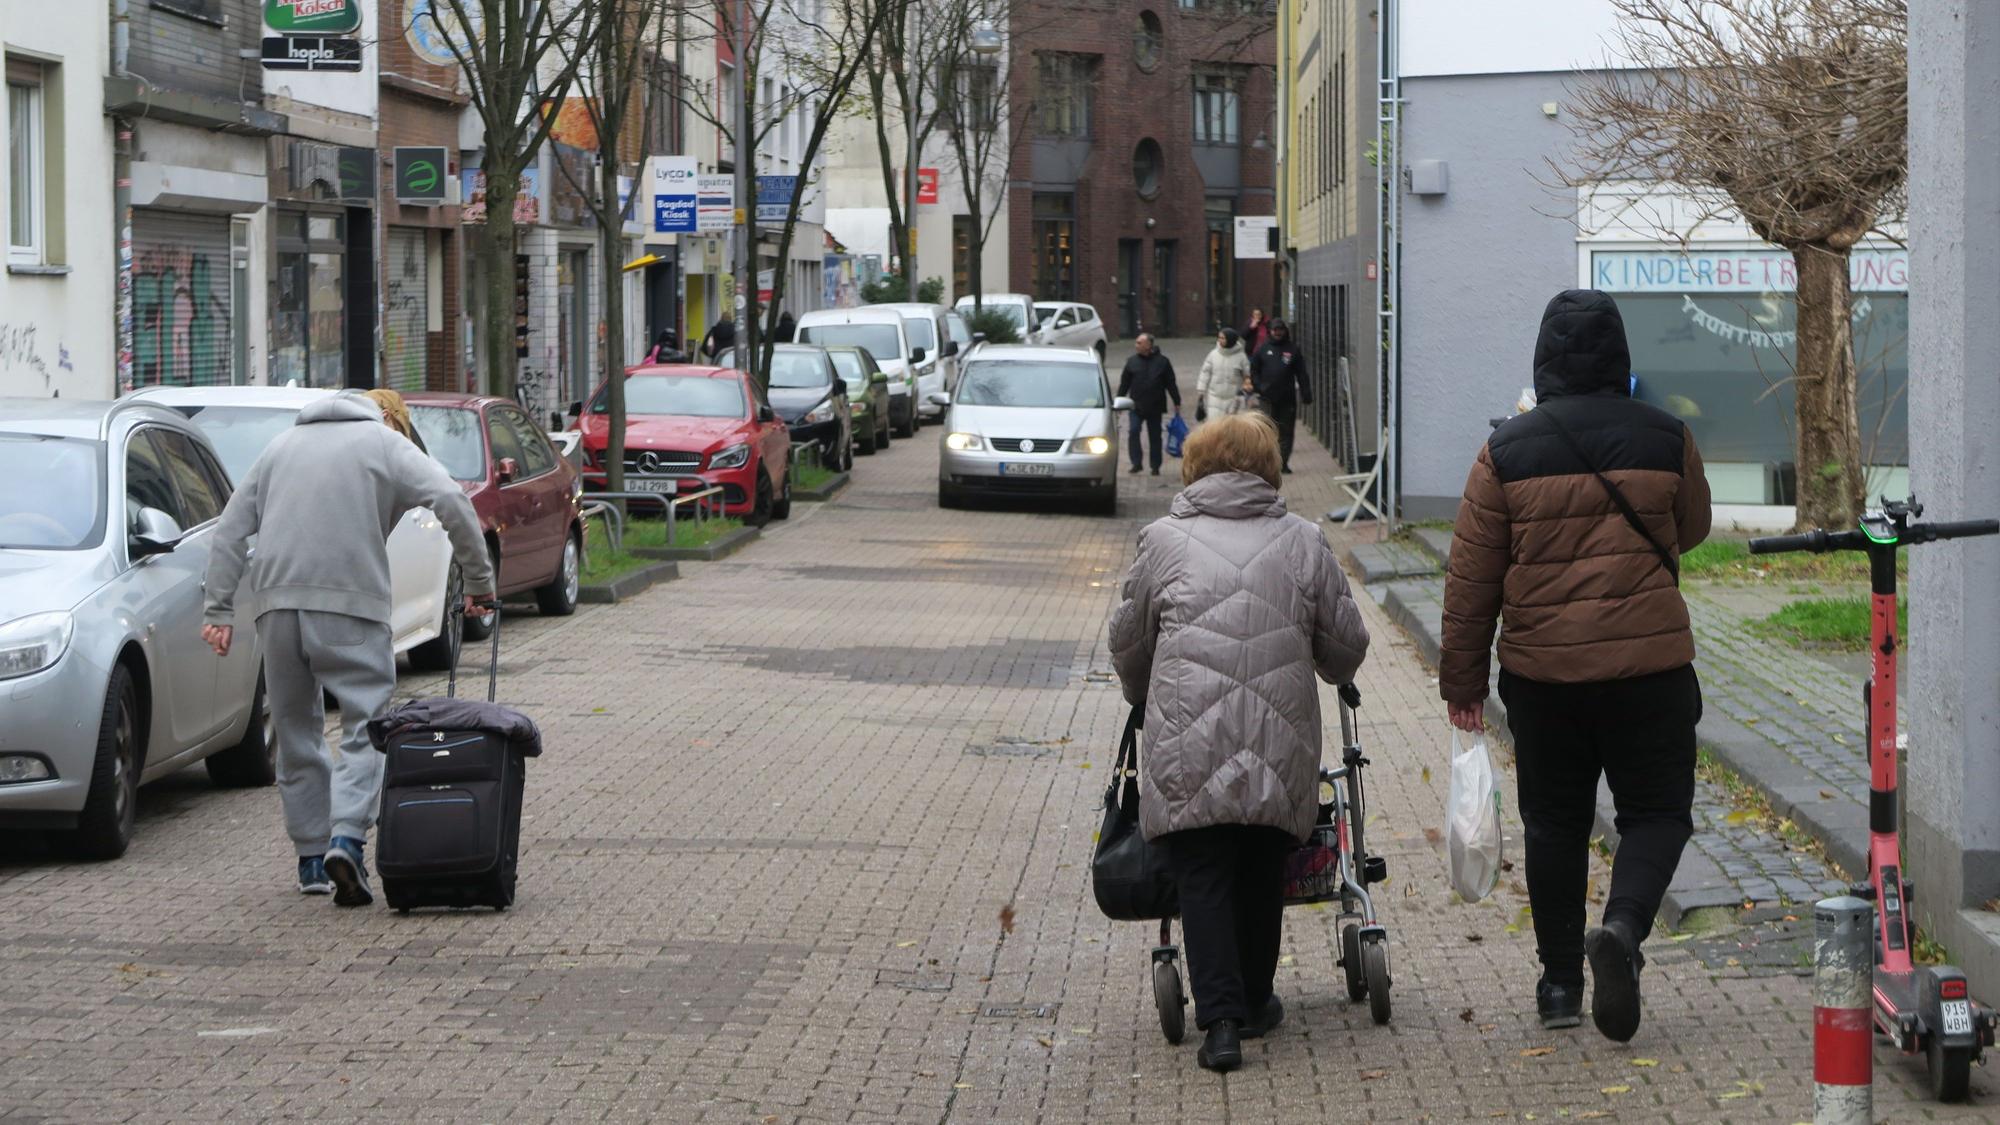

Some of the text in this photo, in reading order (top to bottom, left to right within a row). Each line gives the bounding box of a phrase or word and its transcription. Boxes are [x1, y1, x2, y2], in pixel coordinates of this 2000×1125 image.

[293, 0, 346, 17] Kölsch
[288, 37, 334, 70] hopla
[656, 168, 684, 181] Lyca
[656, 200, 695, 210] Bagdad
[662, 210, 690, 219] Kiosk
[1598, 258, 1906, 287] KINDERBETRUNG
[1945, 1002, 1966, 1015] 915
[1946, 1017, 1969, 1030] WBH
